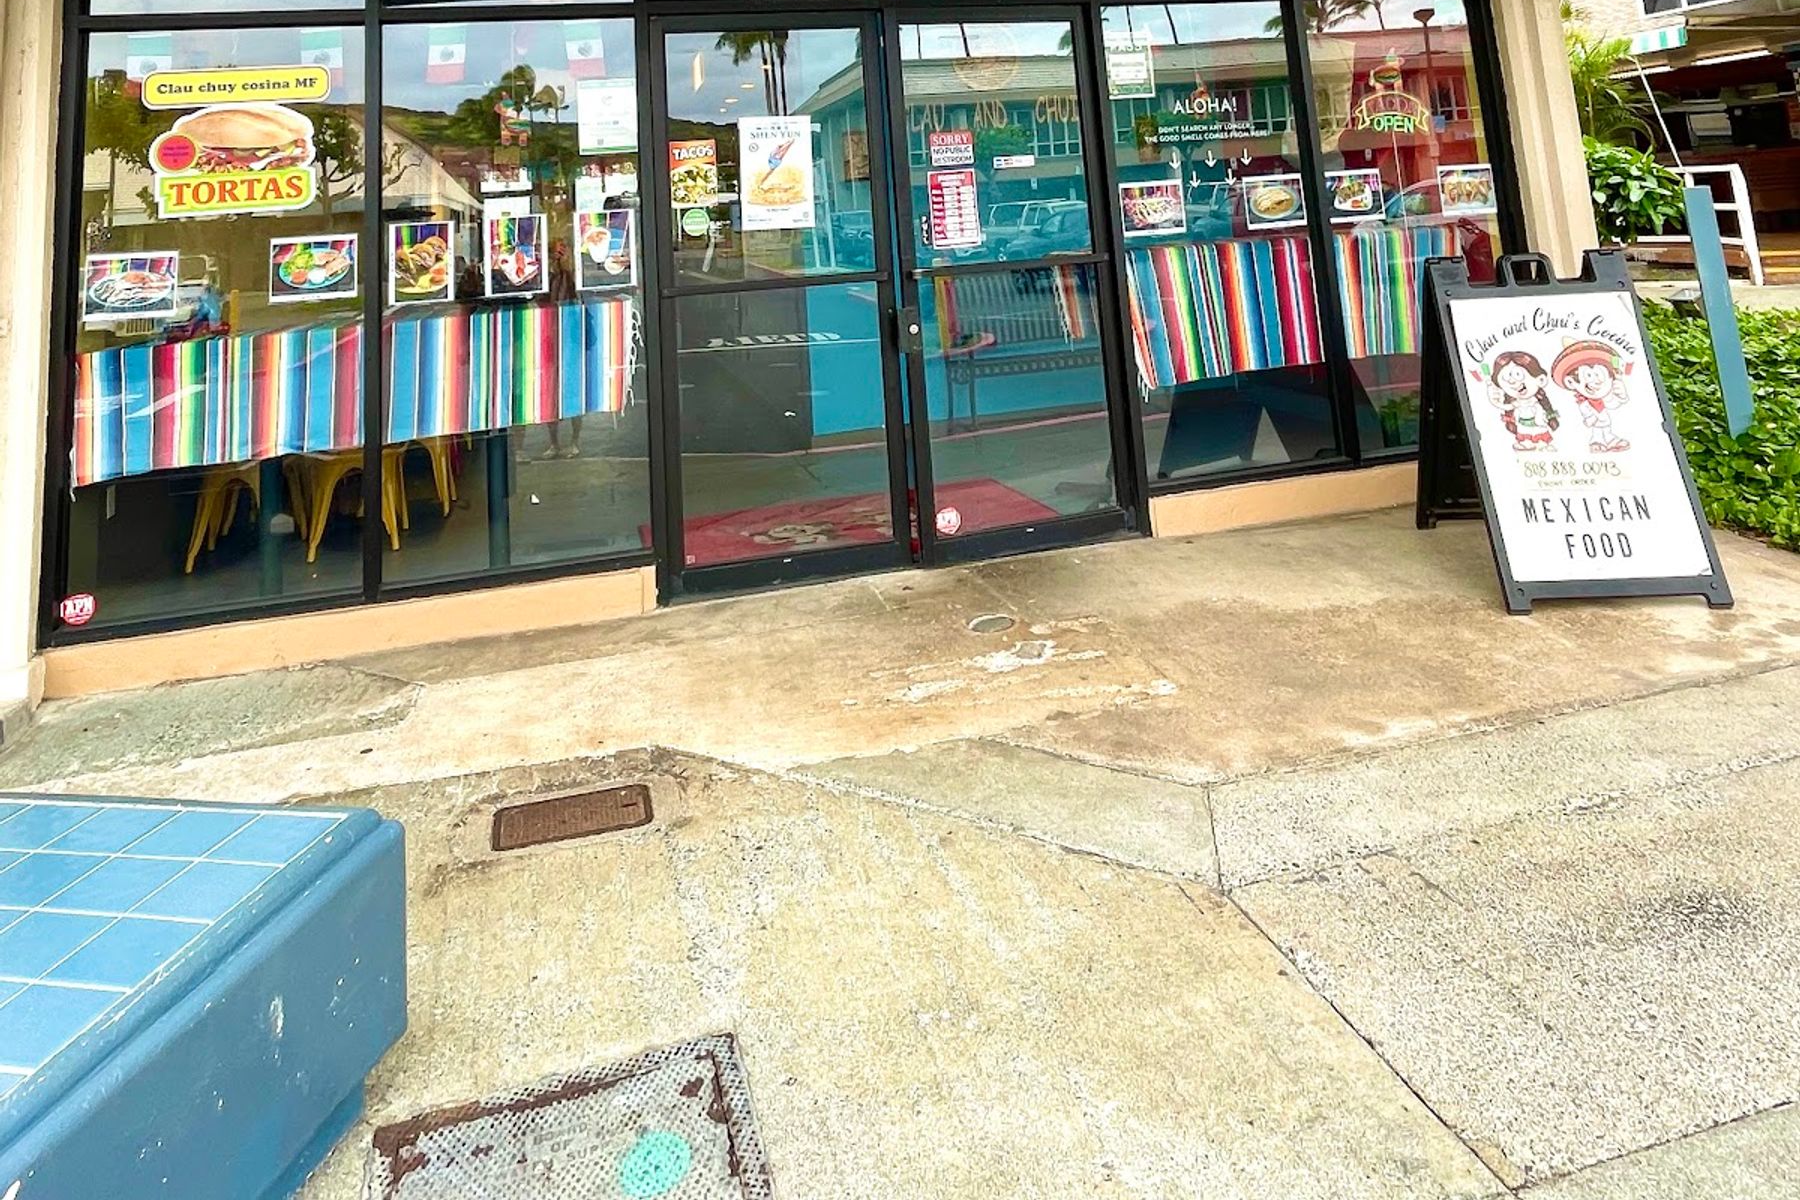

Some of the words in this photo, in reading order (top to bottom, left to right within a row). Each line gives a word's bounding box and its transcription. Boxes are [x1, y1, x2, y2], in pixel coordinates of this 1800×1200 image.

[157, 83, 193, 95] Clau
[198, 82, 237, 94] chuy
[242, 79, 290, 91] cosina
[295, 77, 318, 88] MF
[1173, 97, 1237, 114] ALOHA!
[1373, 116, 1414, 133] OPEN
[932, 133, 968, 146] SORRY
[1159, 134, 1180, 143] GOOD
[672, 146, 714, 161] TACOS
[933, 147, 944, 155] NO
[945, 145, 970, 154] PUBLIC
[934, 155, 972, 164] RESTROOM
[169, 175, 303, 207] TORTAS
[1464, 334, 1499, 363] Clau
[1502, 315, 1528, 338] and
[1587, 315, 1637, 355] Cocina
[1551, 461, 1577, 477] 888
[1522, 495, 1651, 523] MEXICAN
[1565, 532, 1632, 559] FOOD
